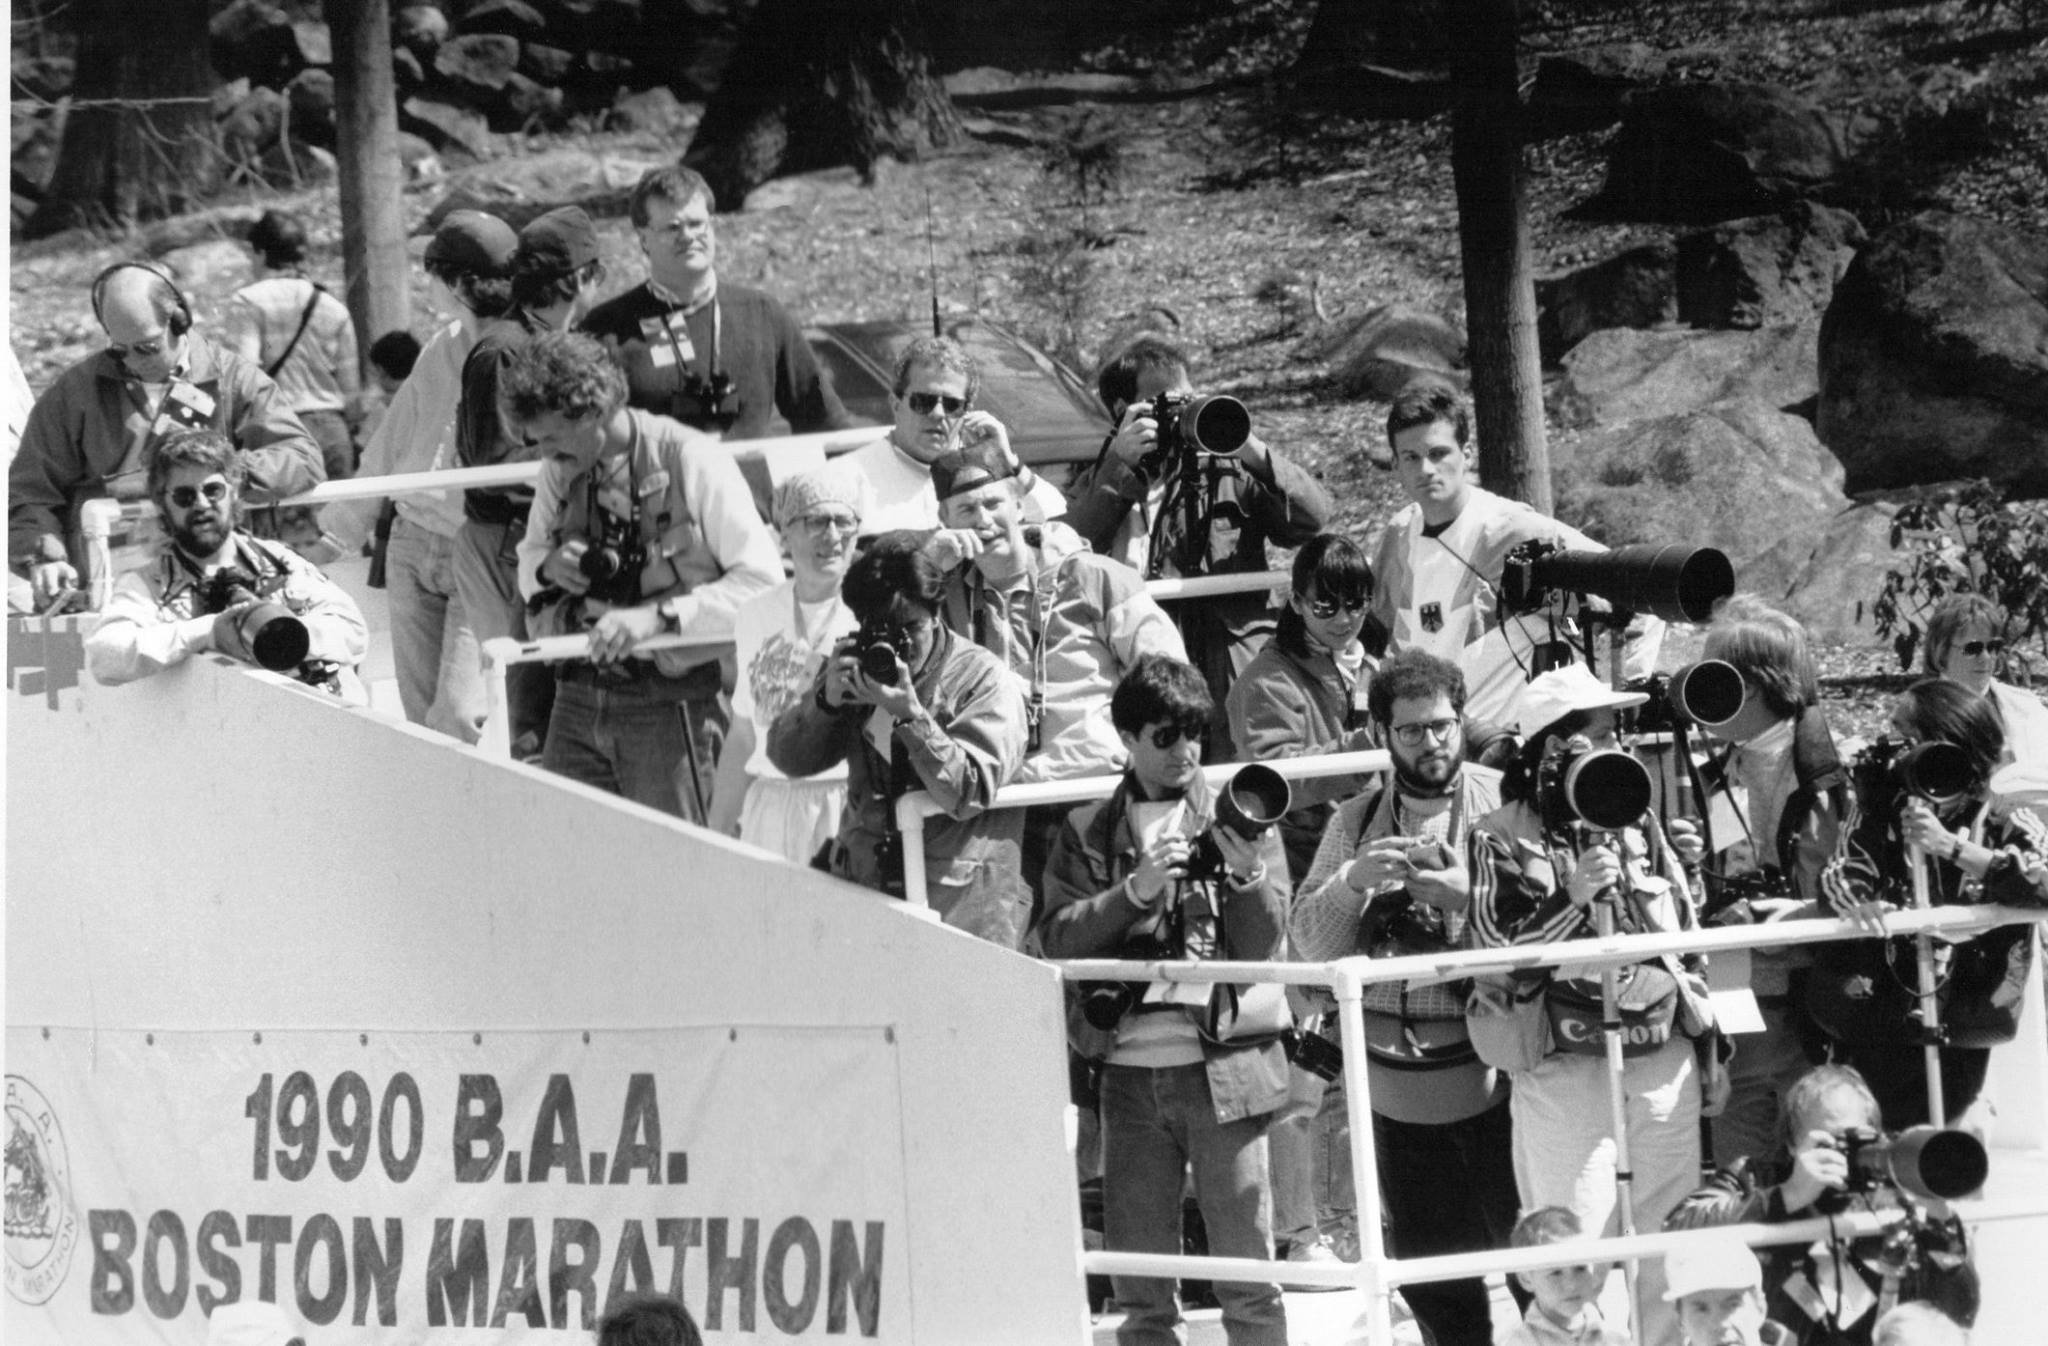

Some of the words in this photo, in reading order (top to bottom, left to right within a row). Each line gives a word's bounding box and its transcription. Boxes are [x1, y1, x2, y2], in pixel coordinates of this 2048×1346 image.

[244, 1070, 424, 1184] 1990
[452, 1072, 689, 1186] B.A.A.
[88, 1208, 404, 1327] BOSTON
[426, 1215, 885, 1338] MARATHON
